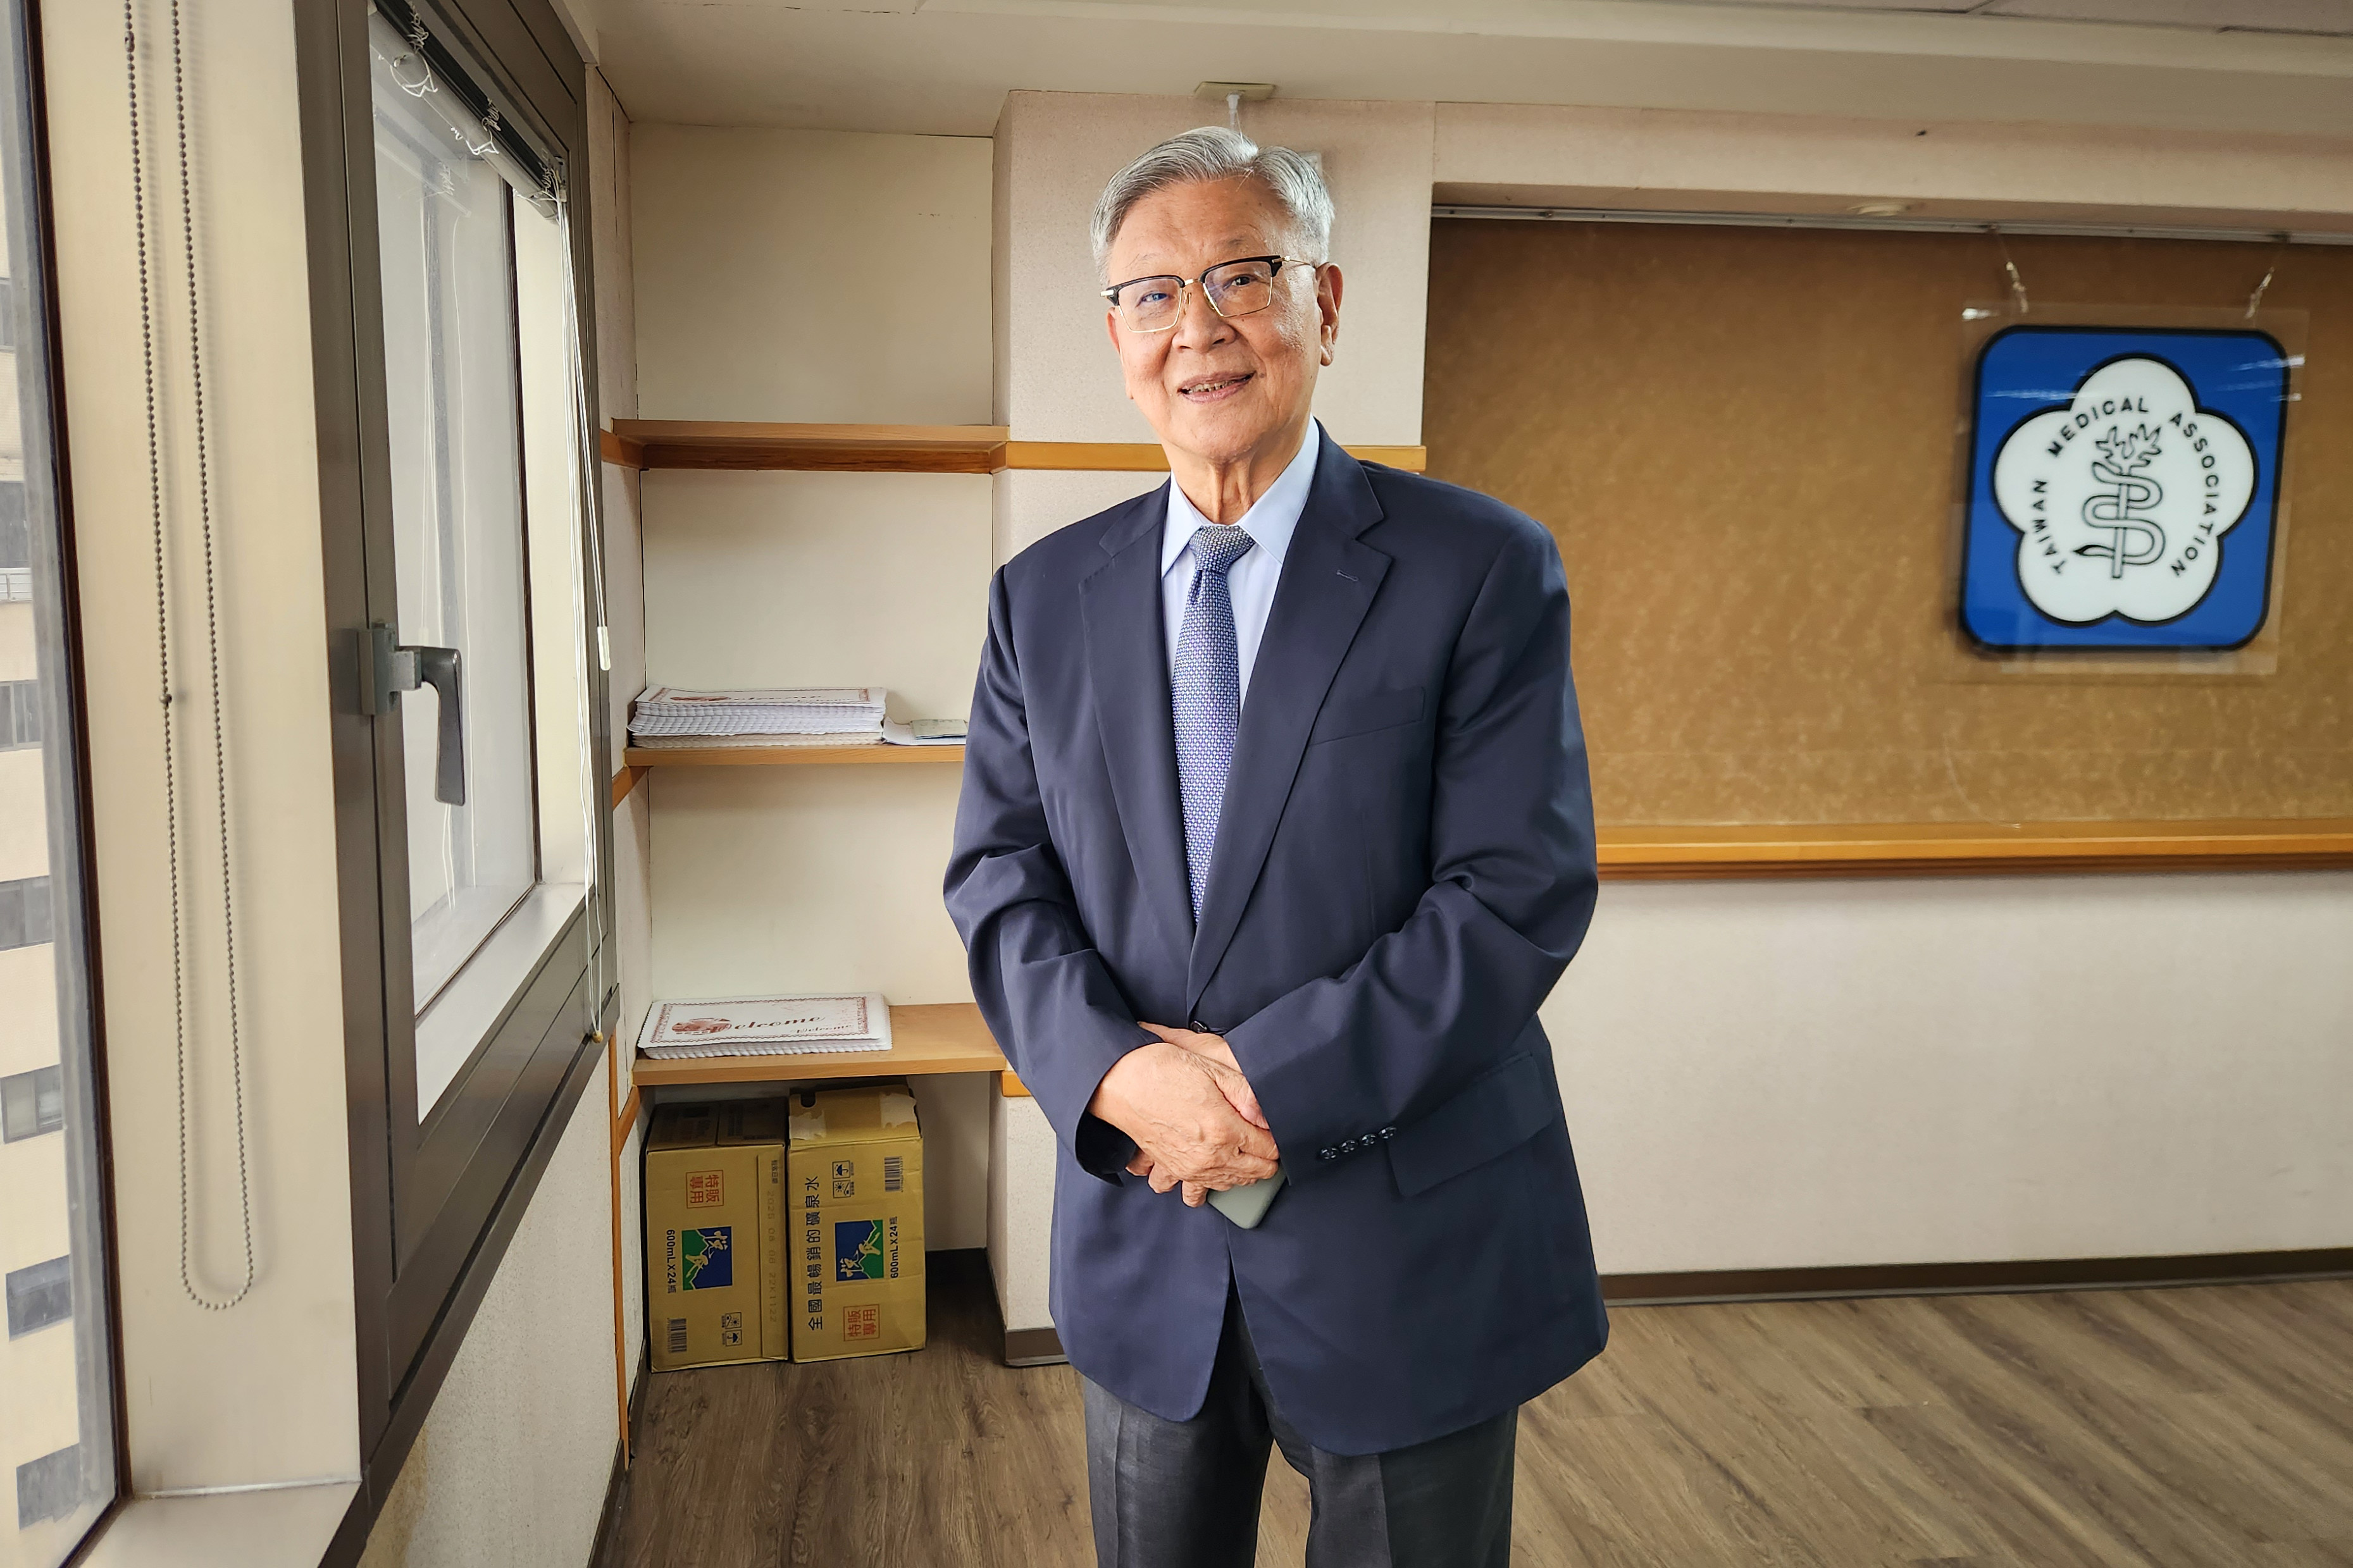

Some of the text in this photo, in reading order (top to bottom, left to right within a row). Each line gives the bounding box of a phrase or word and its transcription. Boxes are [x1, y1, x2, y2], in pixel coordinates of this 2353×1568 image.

[2029, 396, 2221, 577] TAIWAN MEDICAL ASSOCIATION
[689, 1175, 704, 1204] 專用
[705, 1174, 720, 1203] 特販
[804, 1176, 823, 1331] 全國最暢銷的礦泉水
[847, 1309, 862, 1337] 特販
[862, 1308, 877, 1335] 專用
